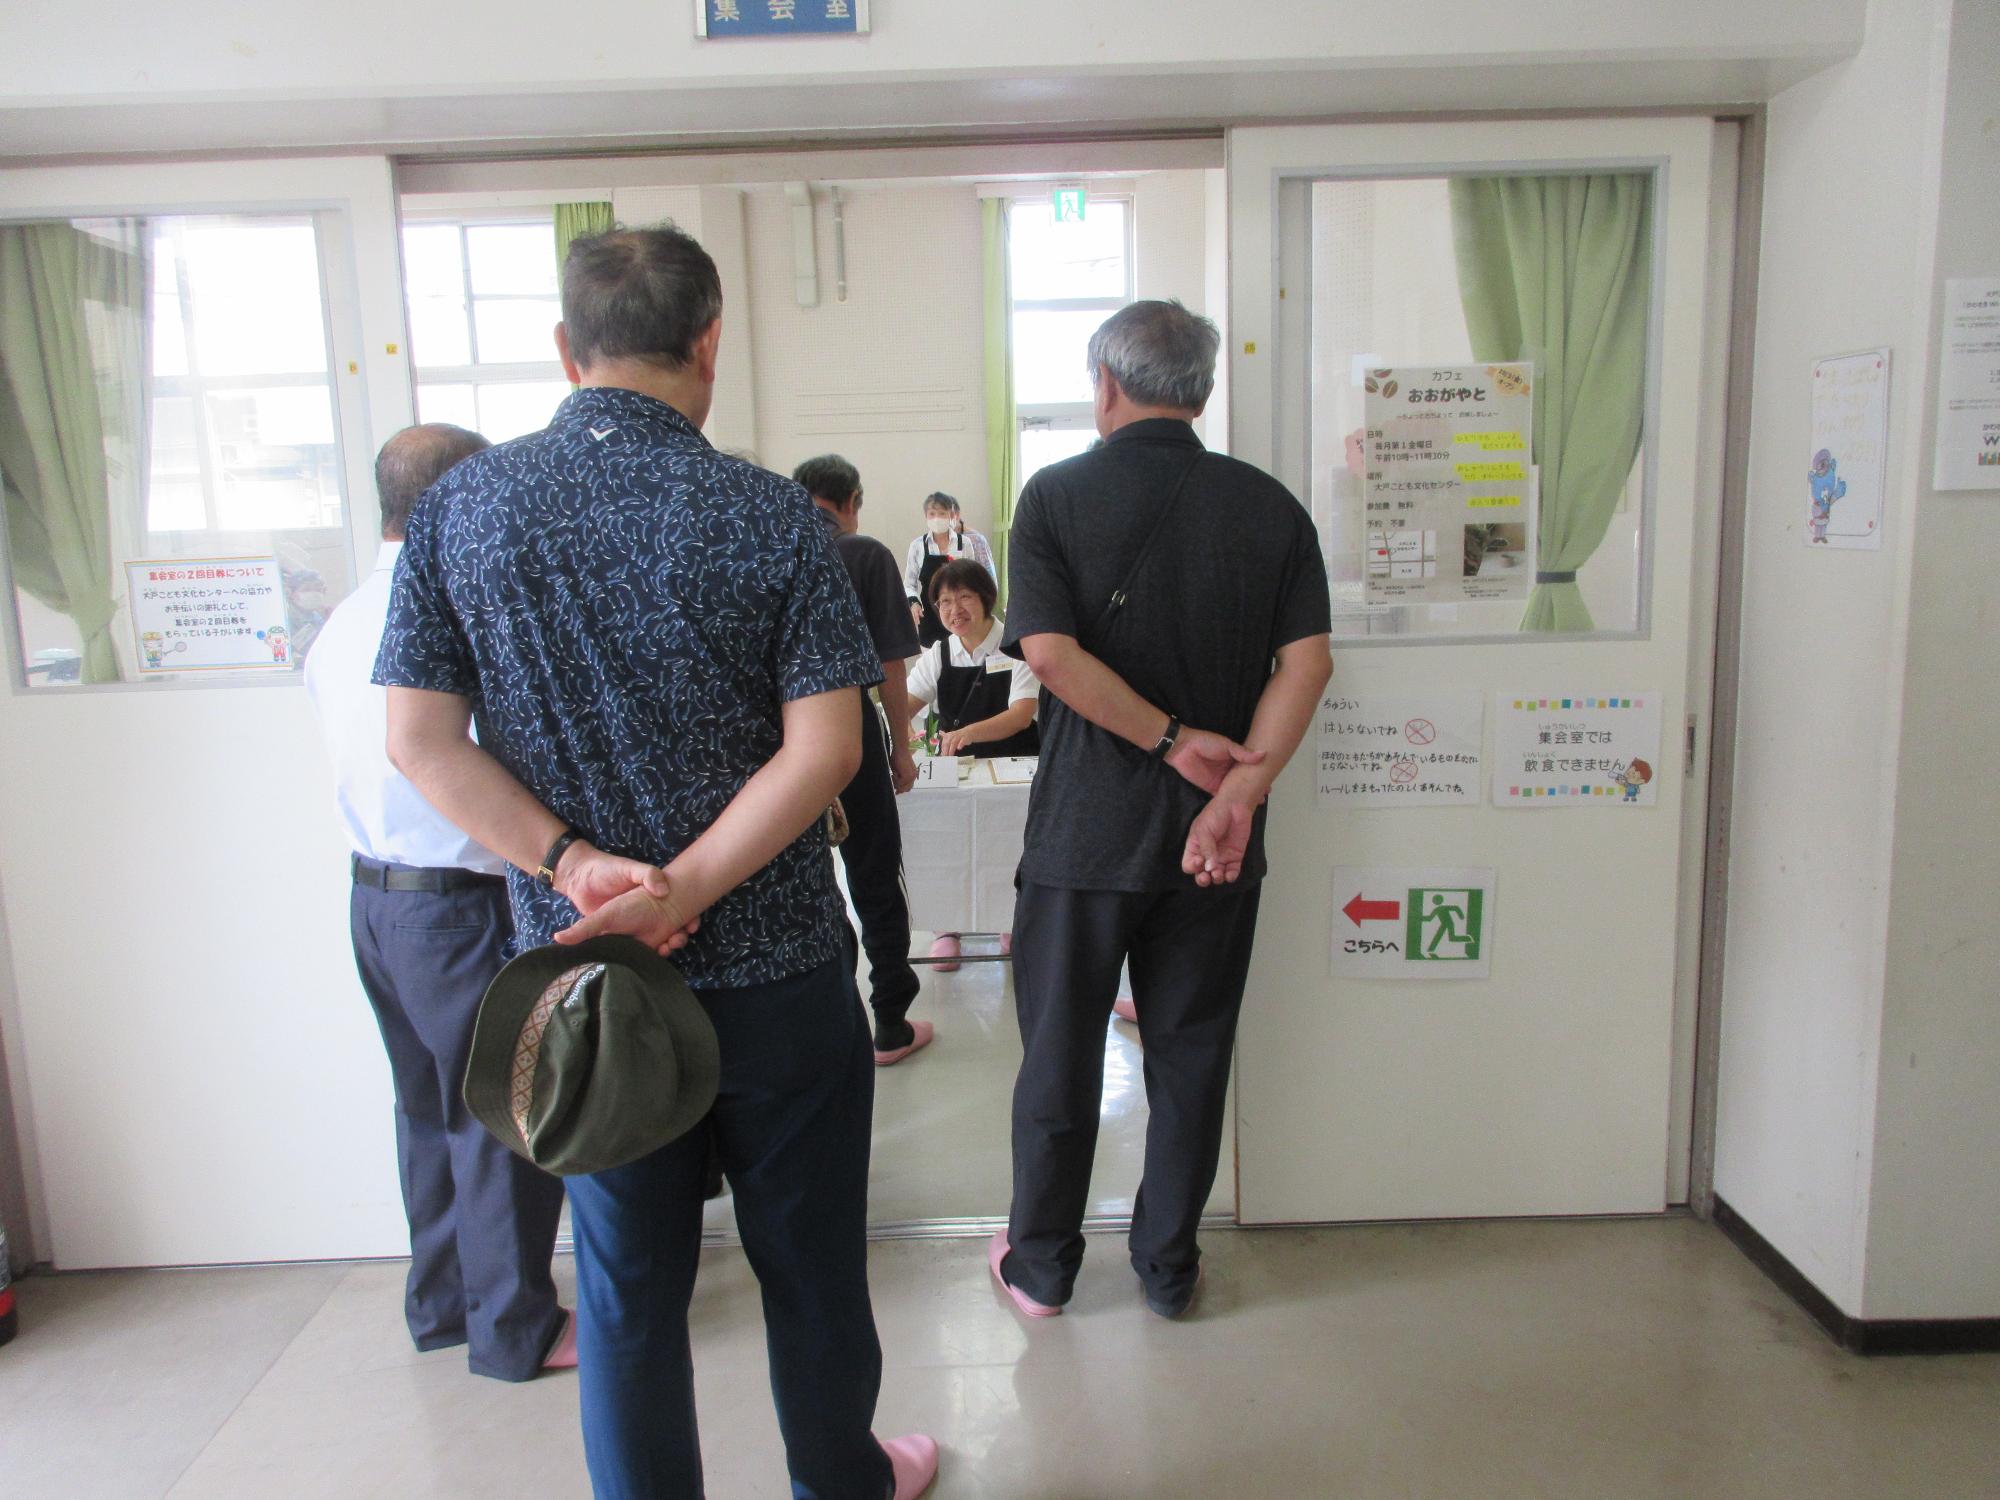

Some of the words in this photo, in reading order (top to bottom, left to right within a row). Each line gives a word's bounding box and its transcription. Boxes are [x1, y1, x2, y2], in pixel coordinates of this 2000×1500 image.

[1432, 371, 1463, 382] カフェ
[1408, 388, 1487, 403] おおがやと
[1367, 431, 1383, 439] 日時
[1375, 481, 1460, 492] 大戸こども文化センター
[1323, 698, 1359, 710] ちゅうい
[1539, 731, 1612, 744] 集会室では
[1524, 758, 1626, 772] 飲食できません
[1344, 939, 1400, 953] こちらへ
[563, 970, 596, 1008] Columbia
